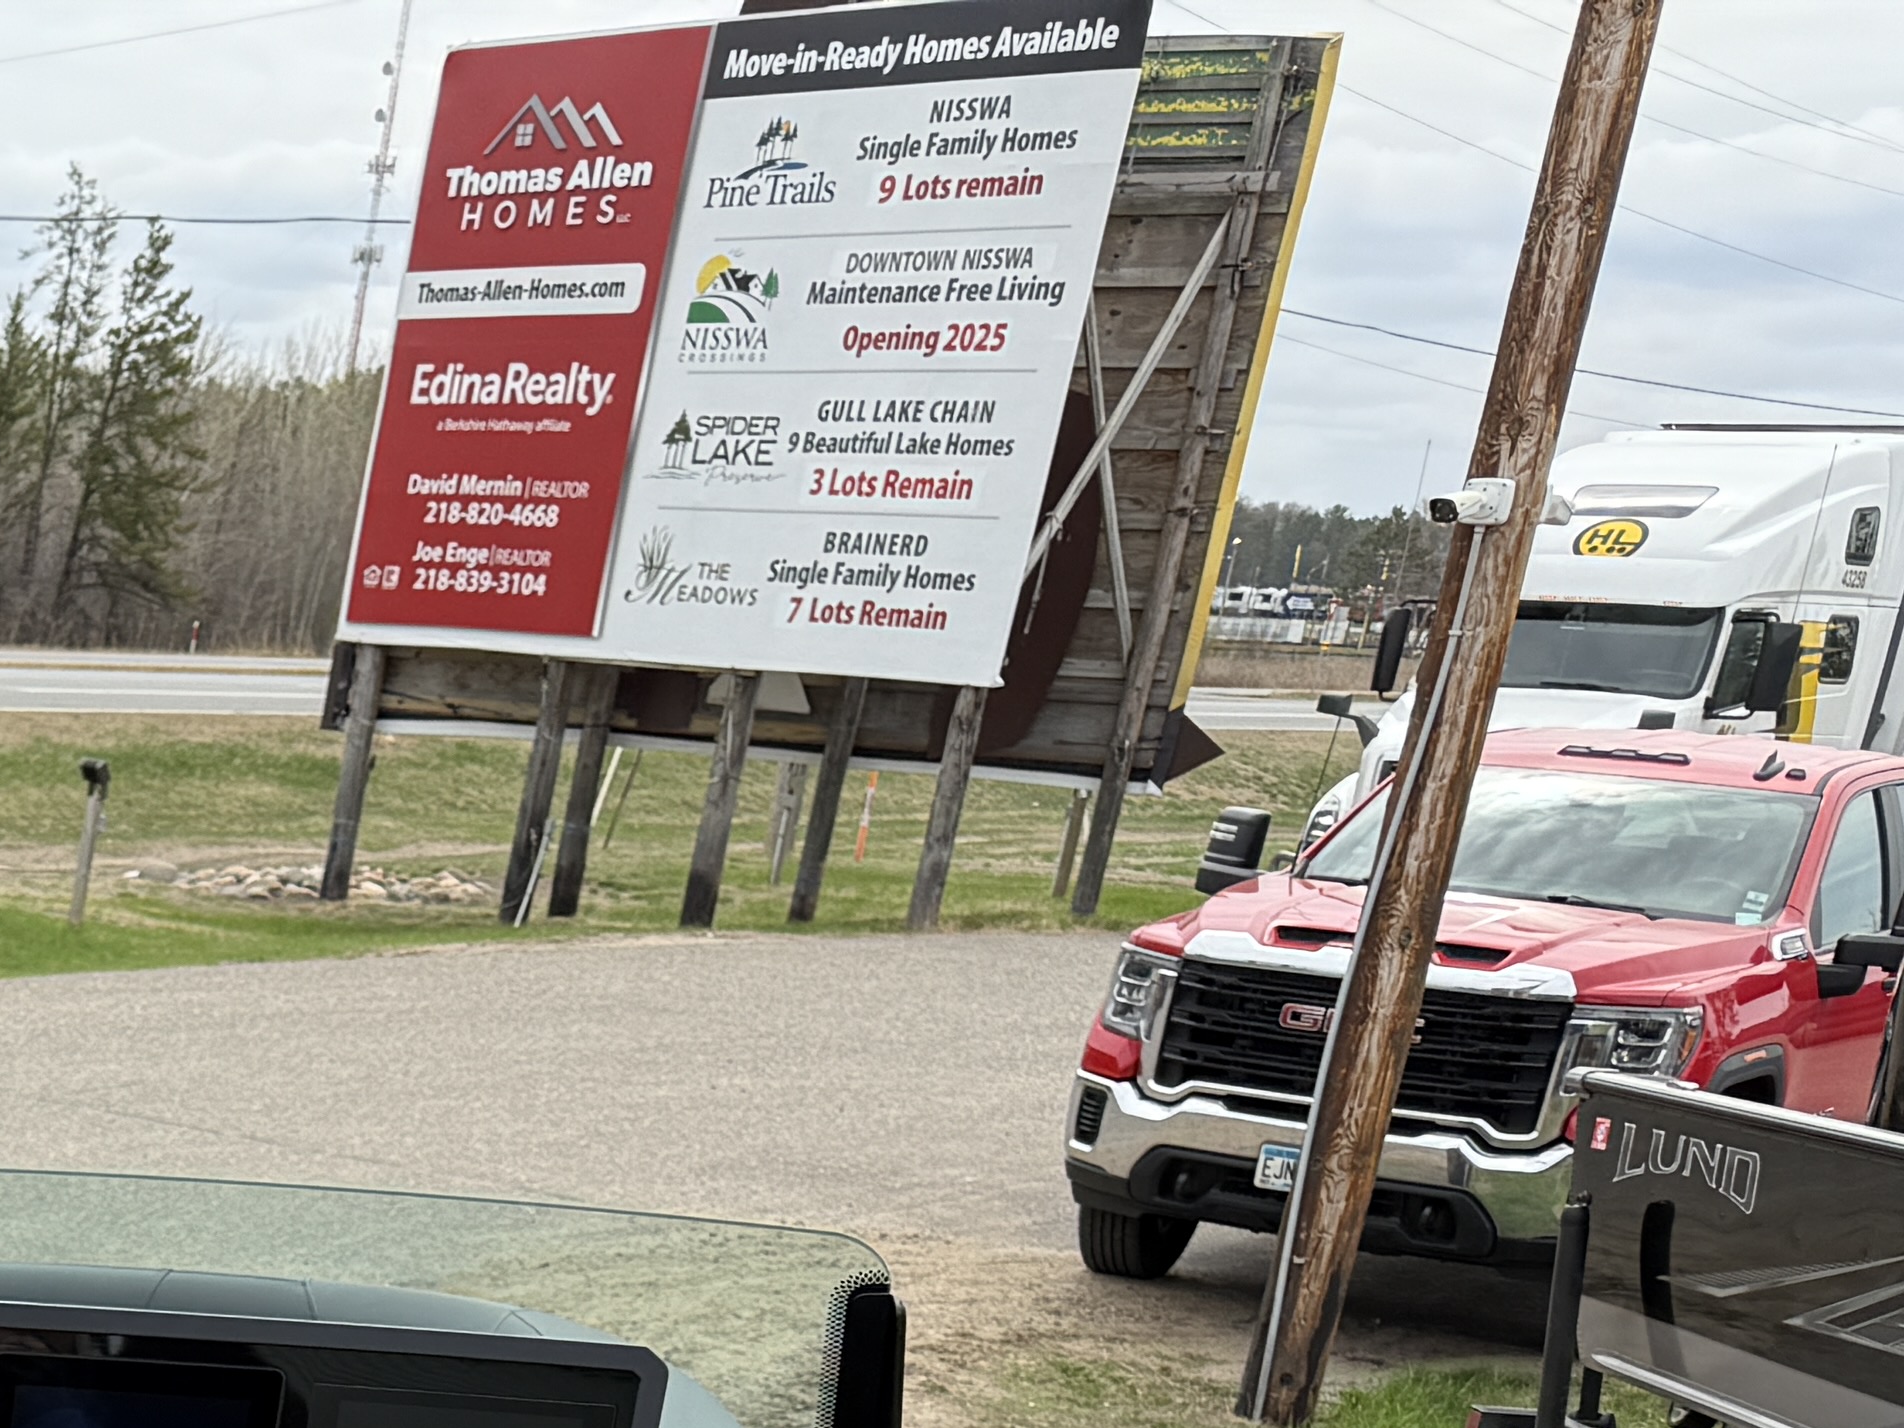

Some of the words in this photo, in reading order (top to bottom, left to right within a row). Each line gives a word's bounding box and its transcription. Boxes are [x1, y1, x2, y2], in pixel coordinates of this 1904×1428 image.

[723, 34, 903, 79] Move-in-Ready
[904, 33, 992, 66] Homes
[993, 17, 1120, 58] Available
[930, 95, 1012, 123] NISSWA
[856, 133, 921, 166] Single
[926, 129, 998, 162] Family
[1001, 128, 1079, 154] Homes
[446, 166, 563, 198] Thomas
[565, 156, 653, 191] Allen
[703, 176, 761, 209] Pine
[763, 171, 837, 204] Trails
[879, 176, 896, 204] 9
[902, 172, 952, 201] Lots
[956, 167, 1044, 199] remain
[460, 194, 617, 231] HOMES
[845, 249, 959, 274] DOWNTOWN
[962, 247, 1033, 271] NISSWA
[418, 279, 625, 304] Thomas-Allen-Homes.com
[806, 279, 944, 306] Maintenance
[946, 277, 992, 302] Free
[996, 275, 1066, 307] Living
[681, 327, 769, 352] NISSWA
[842, 324, 941, 358] Opening
[942, 322, 1009, 353] 2025
[694, 415, 781, 437] SPIDER
[818, 399, 867, 424] GULL
[873, 399, 925, 424] LAKE
[929, 400, 997, 425] CHAIN
[691, 439, 778, 467] LAKE
[787, 432, 800, 455] 9
[802, 431, 894, 456] Beautiful
[895, 433, 943, 457] Lake
[945, 433, 1015, 458] Homes
[407, 473, 459, 496] David
[459, 474, 522, 497] Mernin
[532, 480, 590, 499] REALTOR
[809, 468, 824, 497] 3
[829, 469, 878, 498] Lots
[881, 469, 974, 501] Remain
[424, 501, 560, 528] 218-820-4668
[412, 541, 443, 563] Joe
[445, 541, 490, 568] Enge
[823, 531, 929, 557] BRAINERD
[413, 568, 547, 597] 218-839-3104
[697, 561, 731, 581] THE
[767, 559, 829, 590] Single
[832, 562, 901, 593] Family
[904, 564, 977, 592] Homes
[787, 597, 805, 624] 7
[809, 598, 855, 626] Lots
[858, 600, 949, 632] Remain
[1612, 1121, 1760, 1215] LUND
